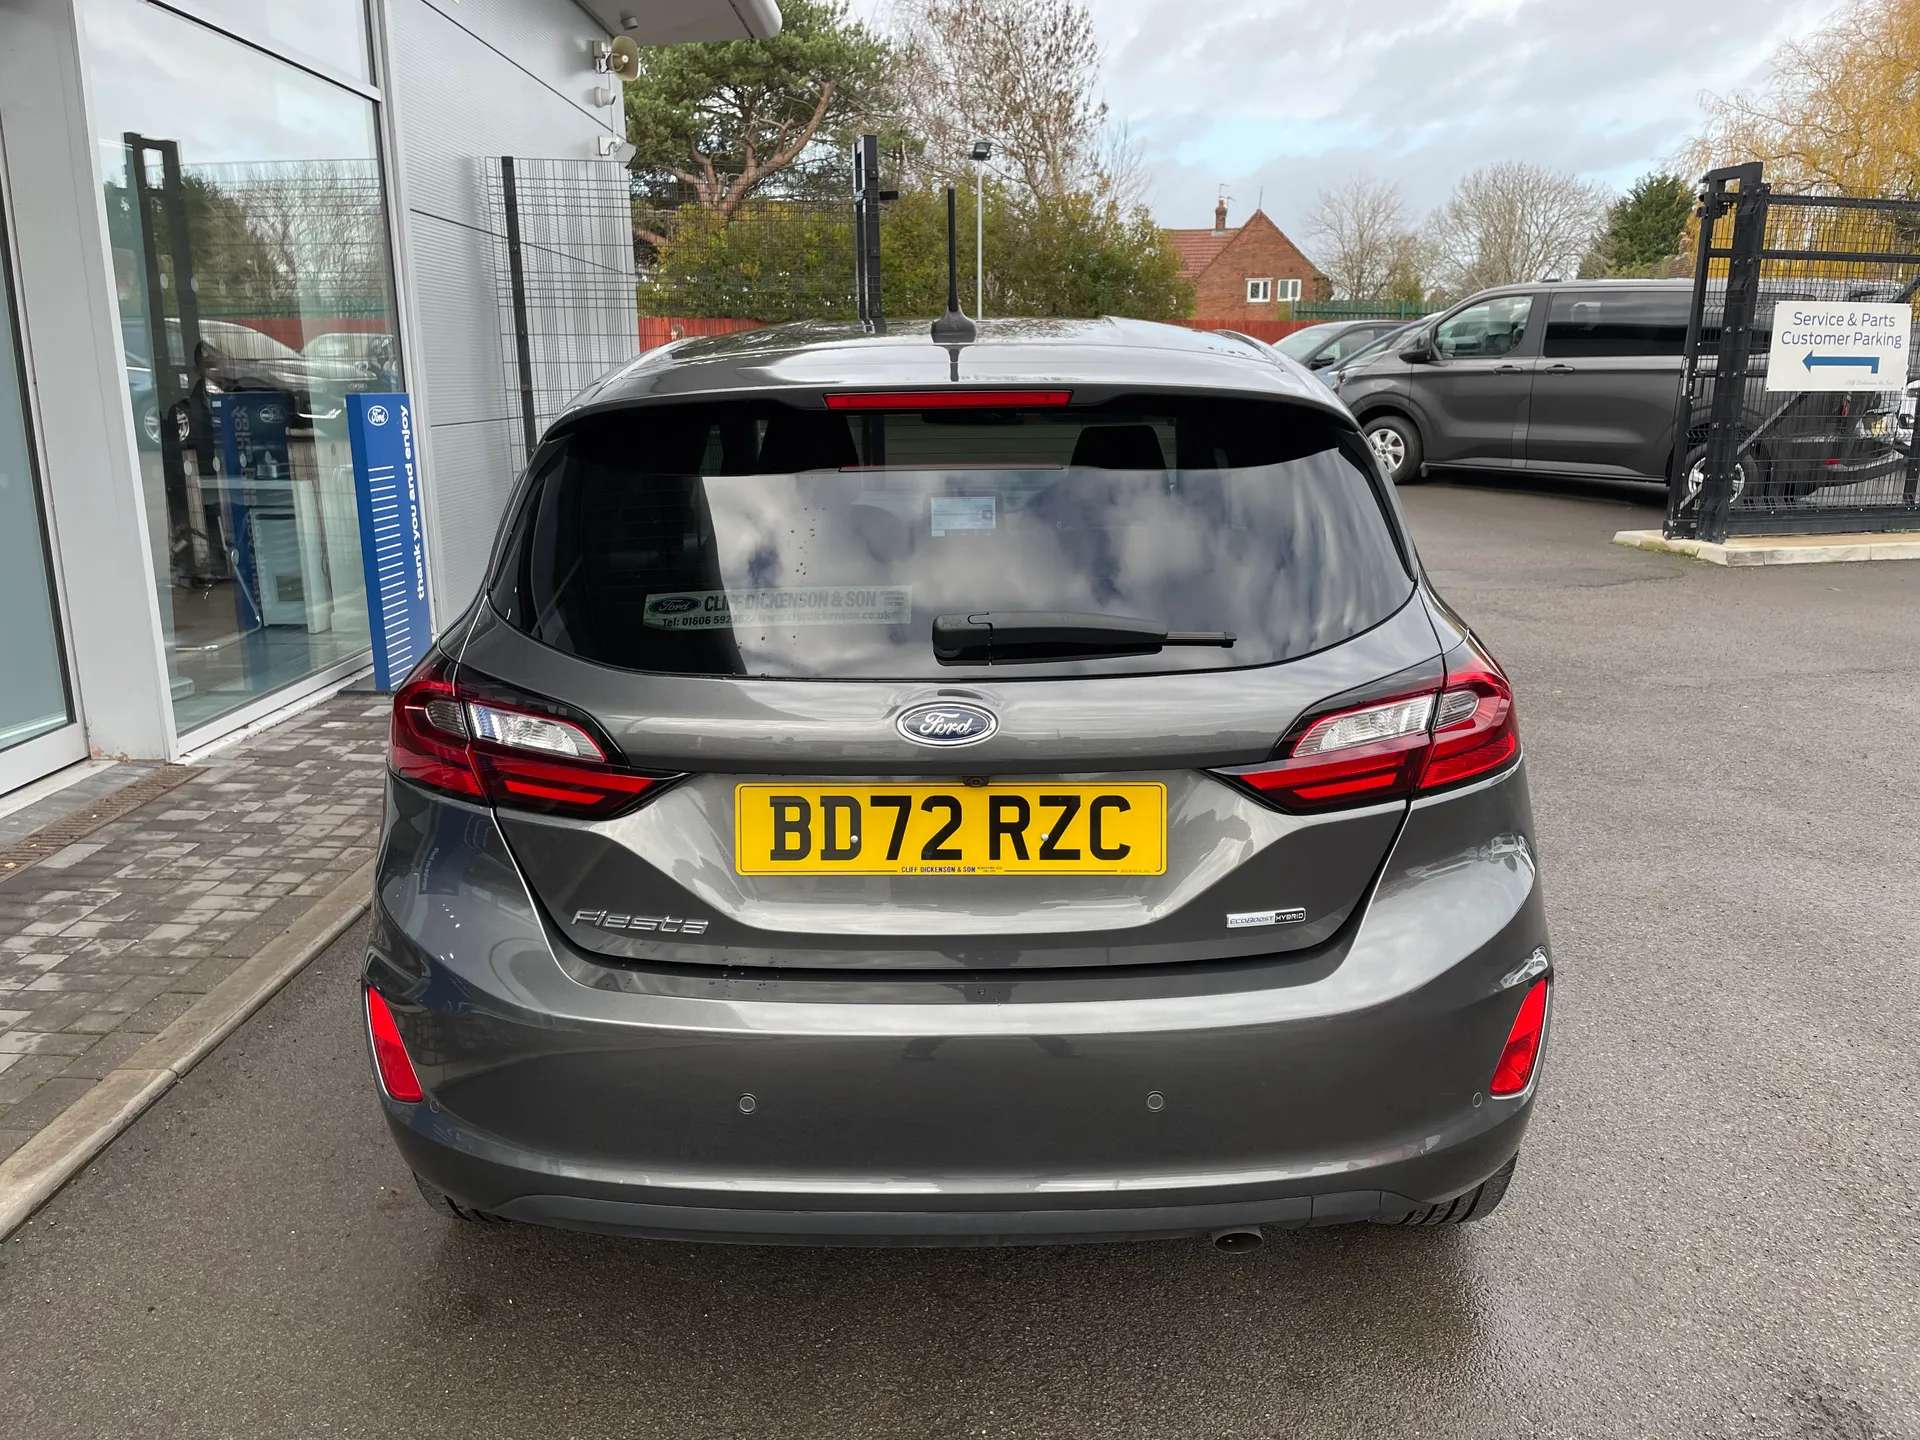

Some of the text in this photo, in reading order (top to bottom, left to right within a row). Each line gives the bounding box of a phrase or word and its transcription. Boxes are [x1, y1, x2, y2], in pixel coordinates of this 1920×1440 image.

[1793, 311, 1895, 327] Service & Parts
[1781, 331, 1902, 349] Customer Parking
[400, 404, 425, 601] thank you and enjoy
[831, 590, 842, 607] &
[845, 590, 876, 607] SON
[662, 618, 680, 627] Tel:
[682, 616, 711, 626] 01606
[769, 795, 1131, 861] BD72 RZC
[571, 910, 709, 935] Fiesta
[1275, 912, 1304, 921] HYBRID
